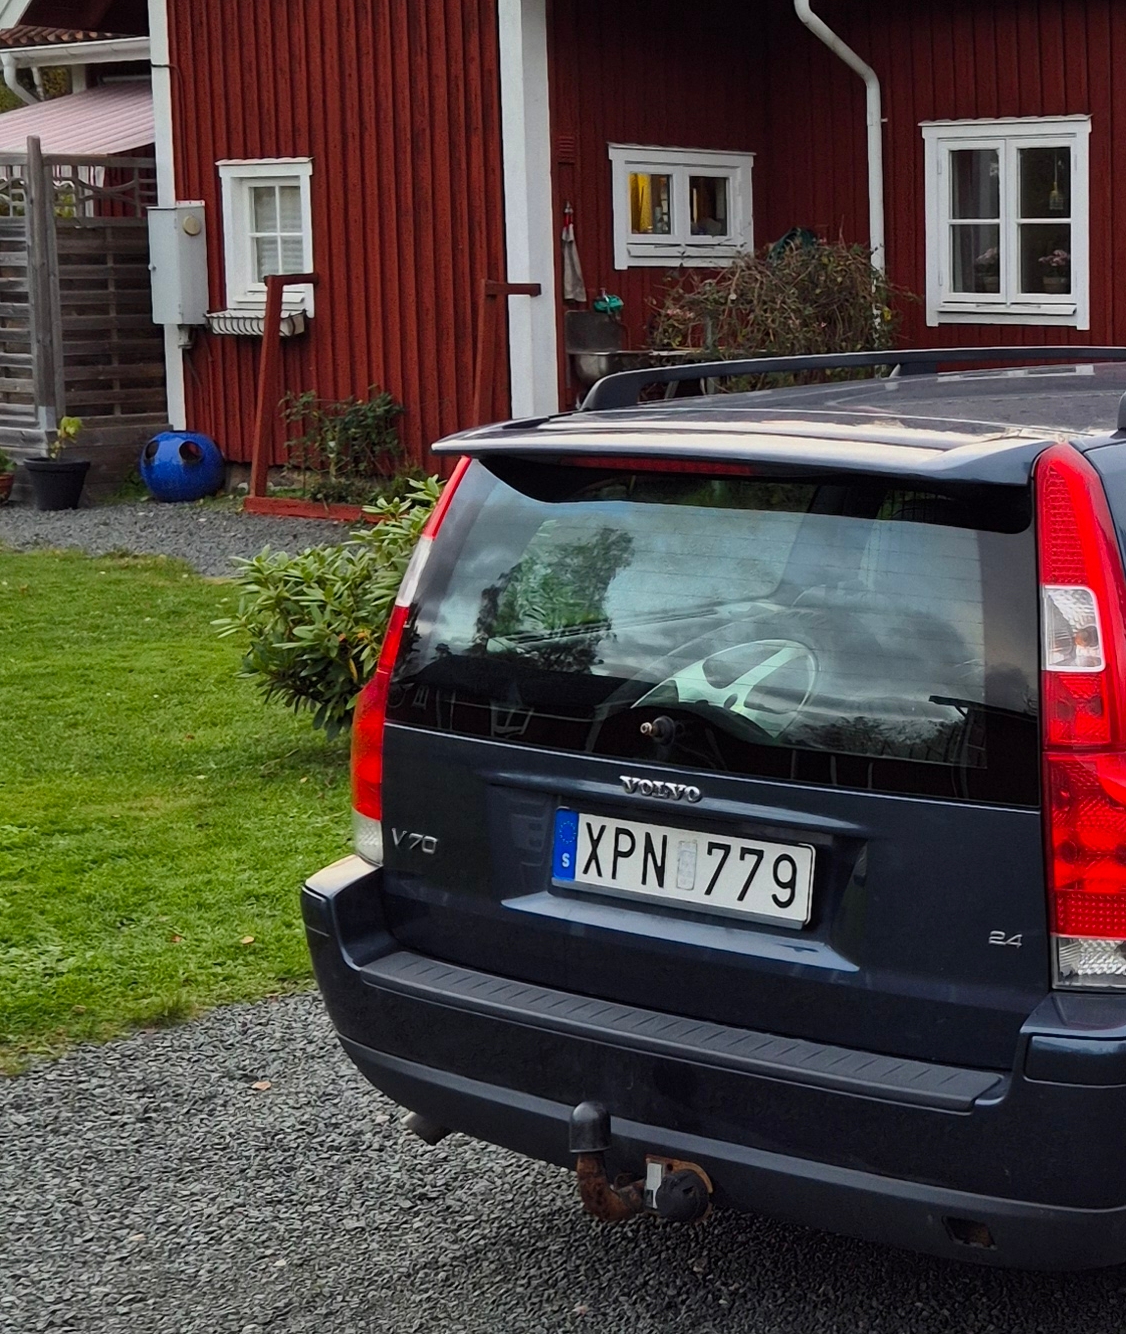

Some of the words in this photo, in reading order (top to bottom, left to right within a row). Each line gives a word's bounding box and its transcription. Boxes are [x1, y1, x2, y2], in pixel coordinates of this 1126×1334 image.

[619, 775, 702, 803] VOLVO
[391, 827, 438, 855] V70
[561, 852, 570, 868] S
[582, 822, 668, 889] XPN
[703, 841, 798, 909] 779
